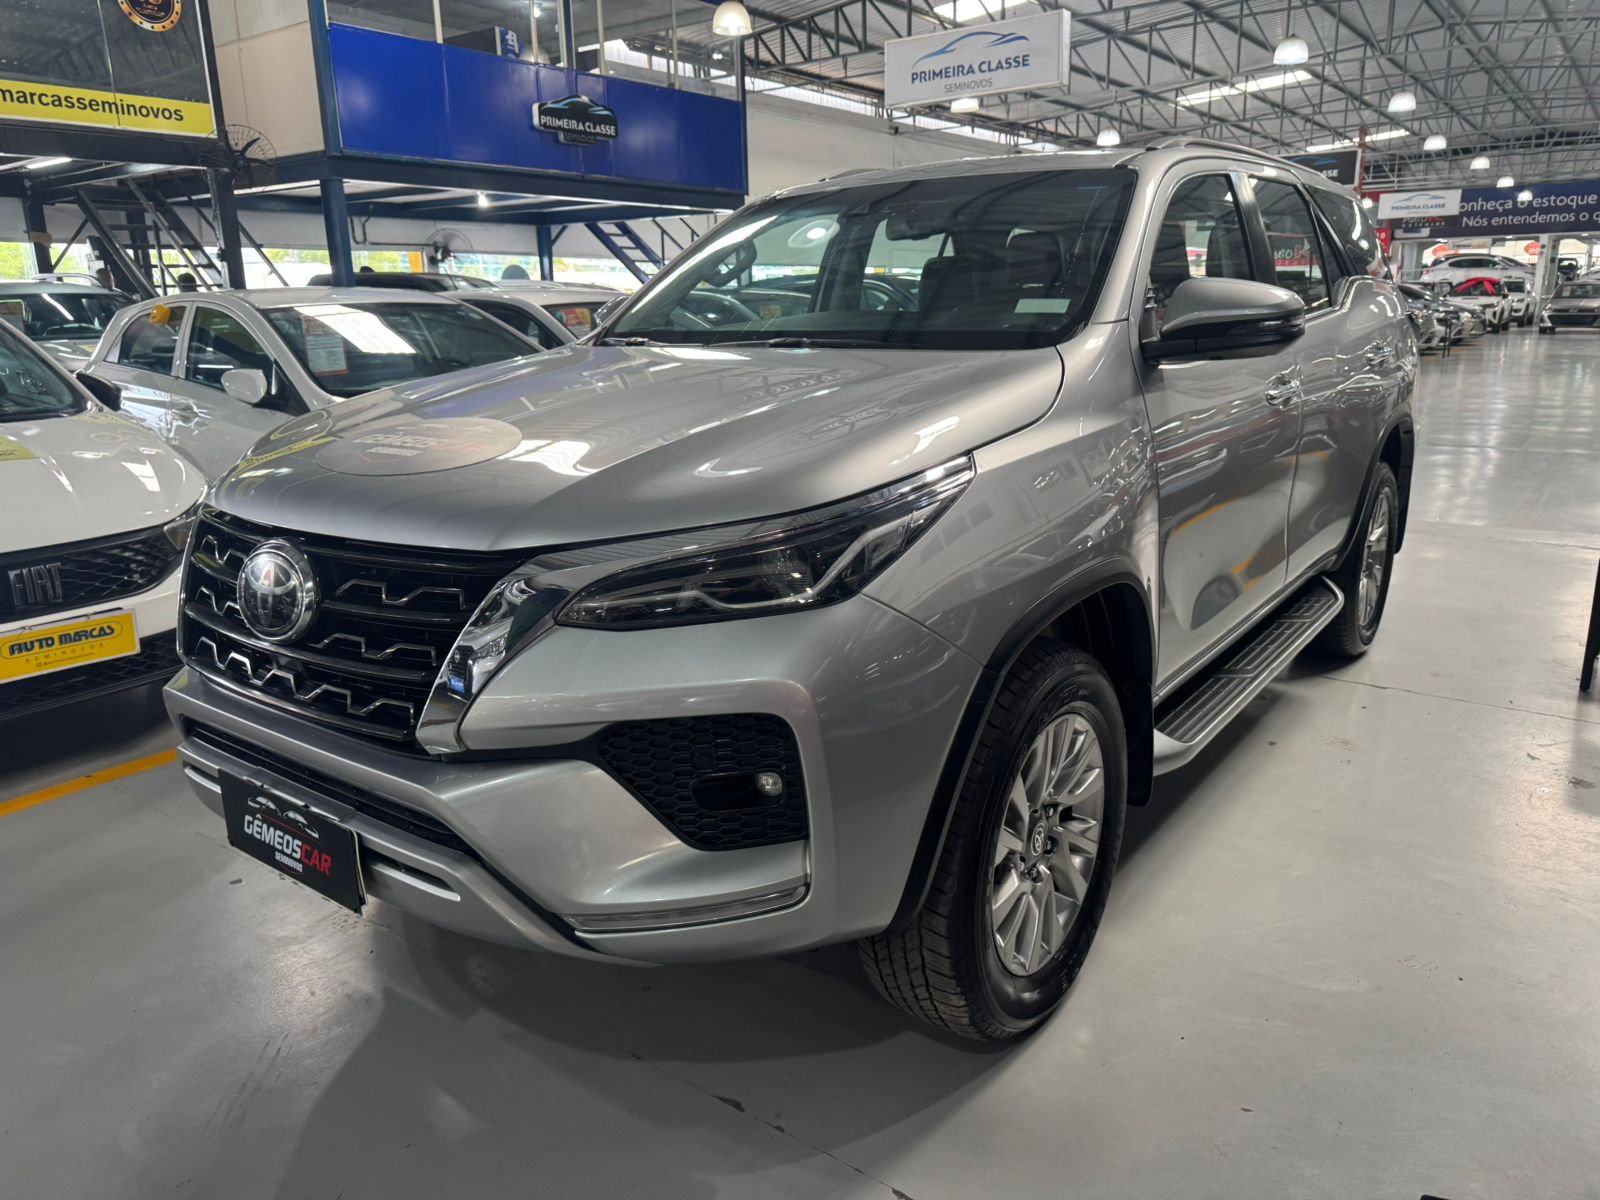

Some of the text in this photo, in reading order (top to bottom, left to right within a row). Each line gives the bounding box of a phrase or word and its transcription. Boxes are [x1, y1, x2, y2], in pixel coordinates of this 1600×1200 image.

[911, 54, 1030, 84] PRIMEIRA CLASSE
[944, 78, 993, 93] SEMINOVOS
[0, 88, 184, 121] marcasseminovos
[541, 116, 616, 136] PRIMEIRA CLASSE
[1321, 169, 1339, 177] SSE
[1460, 197, 1512, 212] onheça
[1533, 194, 1597, 209] estoque
[1462, 216, 1488, 227] Nós
[1491, 211, 1575, 226] entendemos
[1579, 212, 1589, 220] o
[8, 562, 63, 609] FIAT
[9, 625, 115, 656] AUTO MARCAS
